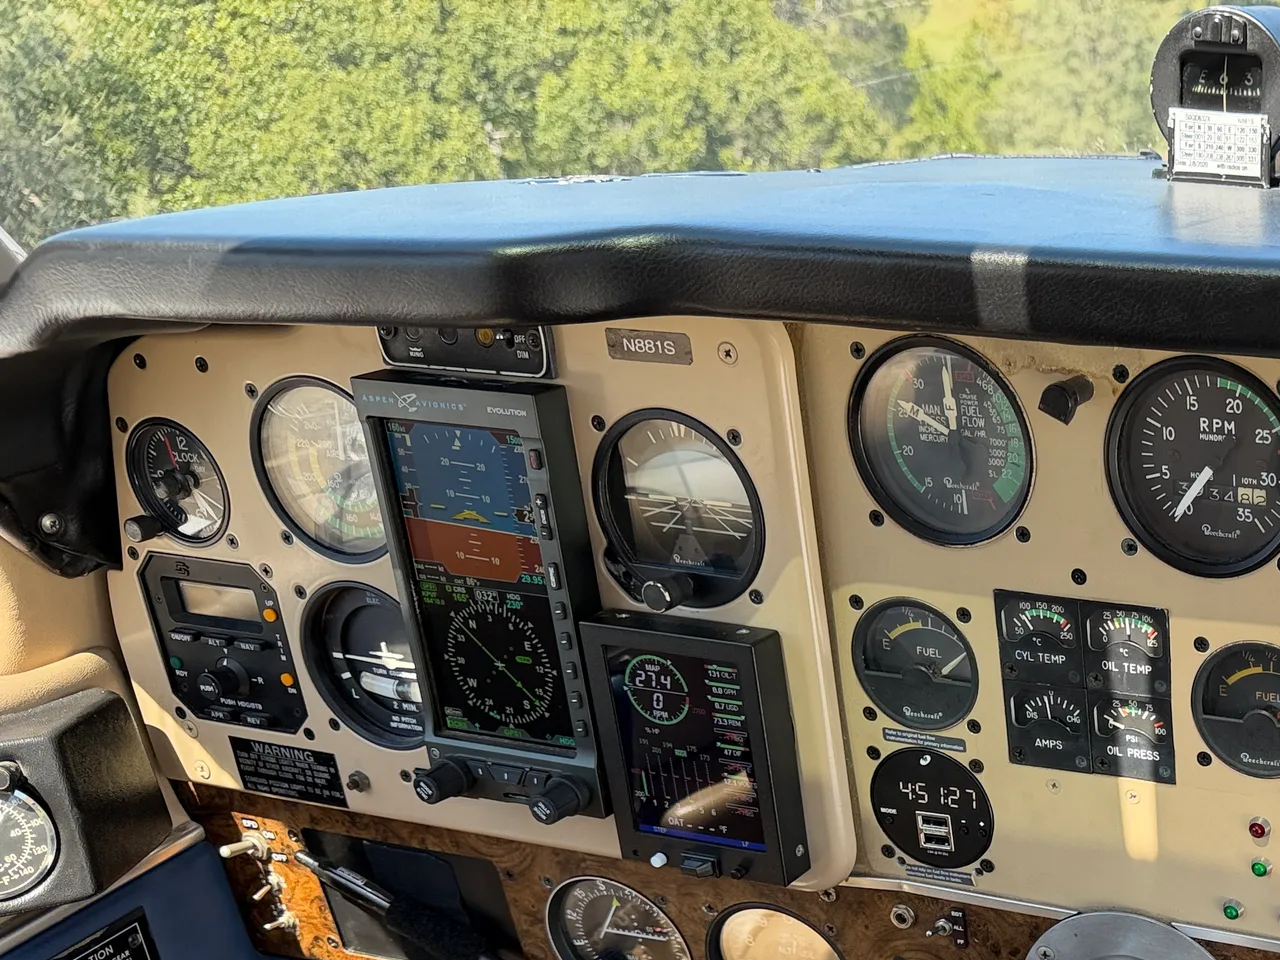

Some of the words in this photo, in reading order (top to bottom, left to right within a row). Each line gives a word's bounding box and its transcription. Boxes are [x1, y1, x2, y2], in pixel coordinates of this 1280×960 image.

[1245, 73, 1253, 85] 3
[623, 338, 675, 354] N881S
[362, 394, 394, 404] ASPEN
[1187, 396, 1198, 410] 15
[487, 407, 527, 416] EVOLUTION
[961, 406, 982, 417] FUEL
[1226, 399, 1242, 414] 20
[962, 417, 985, 428] FLOW
[920, 434, 949, 443] MERCURY
[1255, 429, 1271, 444] 25
[177, 437, 188, 450] 12
[173, 451, 200, 463] CLOCK
[902, 446, 913, 455] 20
[1260, 473, 1276, 486] 30
[1236, 508, 1252, 522] 35
[916, 646, 942, 658] FUEL
[1015, 651, 1035, 663] CYL
[1038, 653, 1066, 665] TEMP
[1101, 660, 1120, 672] OIL
[1123, 662, 1152, 675] TEMP
[636, 671, 671, 689] 27.4
[1035, 738, 1063, 750] AMPS
[251, 742, 314, 762] WARNING
[1107, 745, 1123, 757] OIL
[1127, 748, 1160, 762] PRESS
[880, 807, 897, 815] MODE
